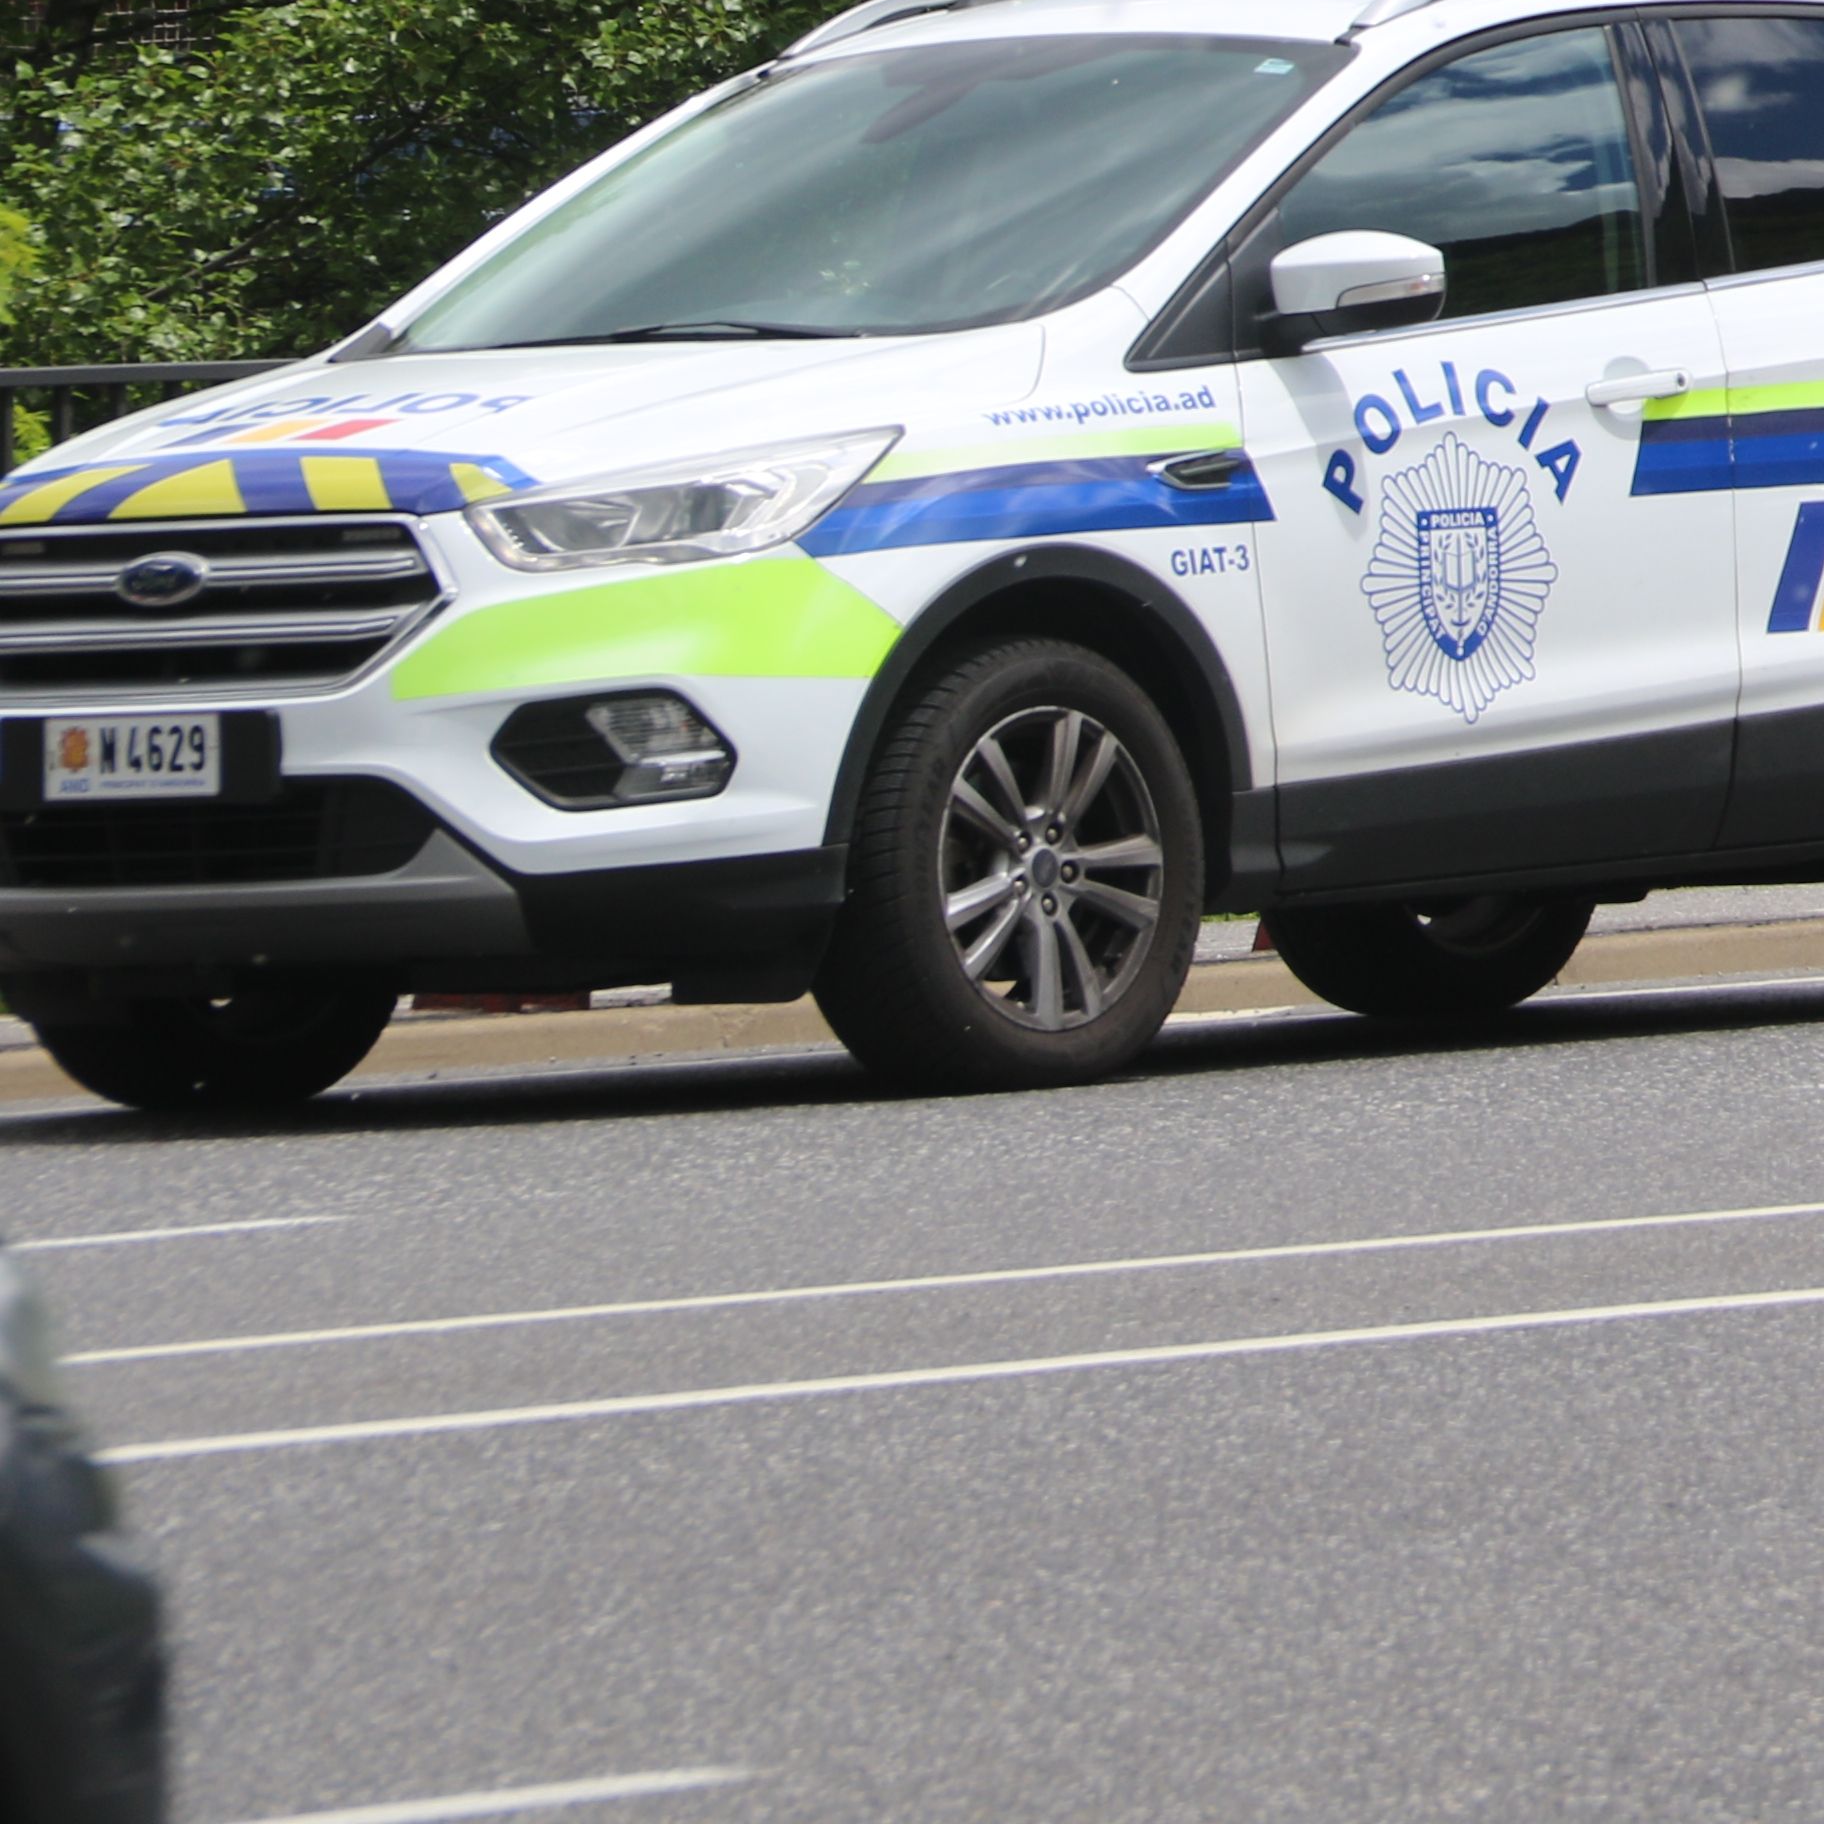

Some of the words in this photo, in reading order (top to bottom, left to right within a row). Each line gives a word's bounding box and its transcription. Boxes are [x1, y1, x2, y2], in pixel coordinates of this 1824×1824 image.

[982, 384, 1217, 426] www.policia.ad
[1322, 361, 1582, 515] POLICIA
[1430, 511, 1486, 528] POLICIA
[1170, 544, 1251, 577] GIAT-3
[127, 724, 206, 773] 4629
